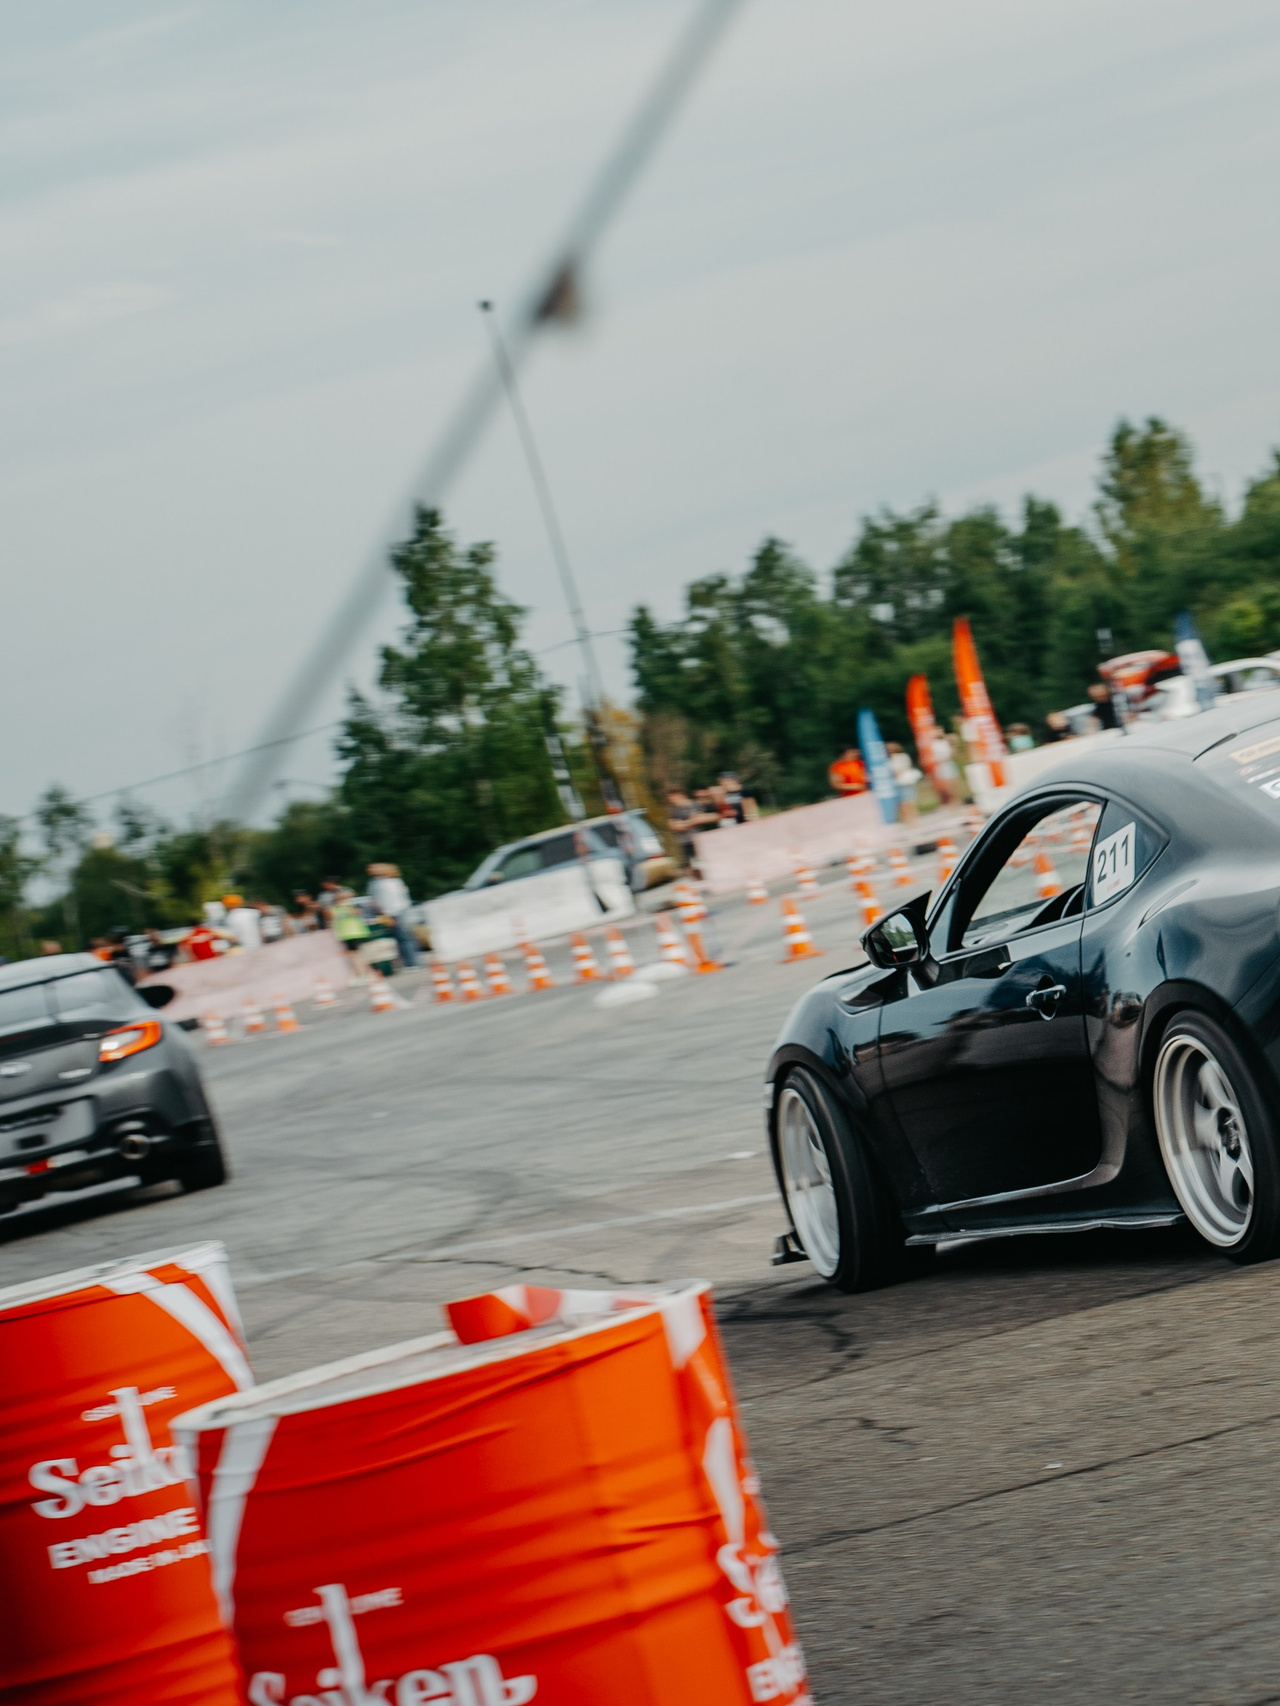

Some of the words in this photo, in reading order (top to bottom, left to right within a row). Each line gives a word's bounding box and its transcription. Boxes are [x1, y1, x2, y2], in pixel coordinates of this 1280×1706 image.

[1097, 833, 1129, 884] 211
[47, 1506, 200, 1569] ENGINE
[87, 1556, 154, 1584] MADE
